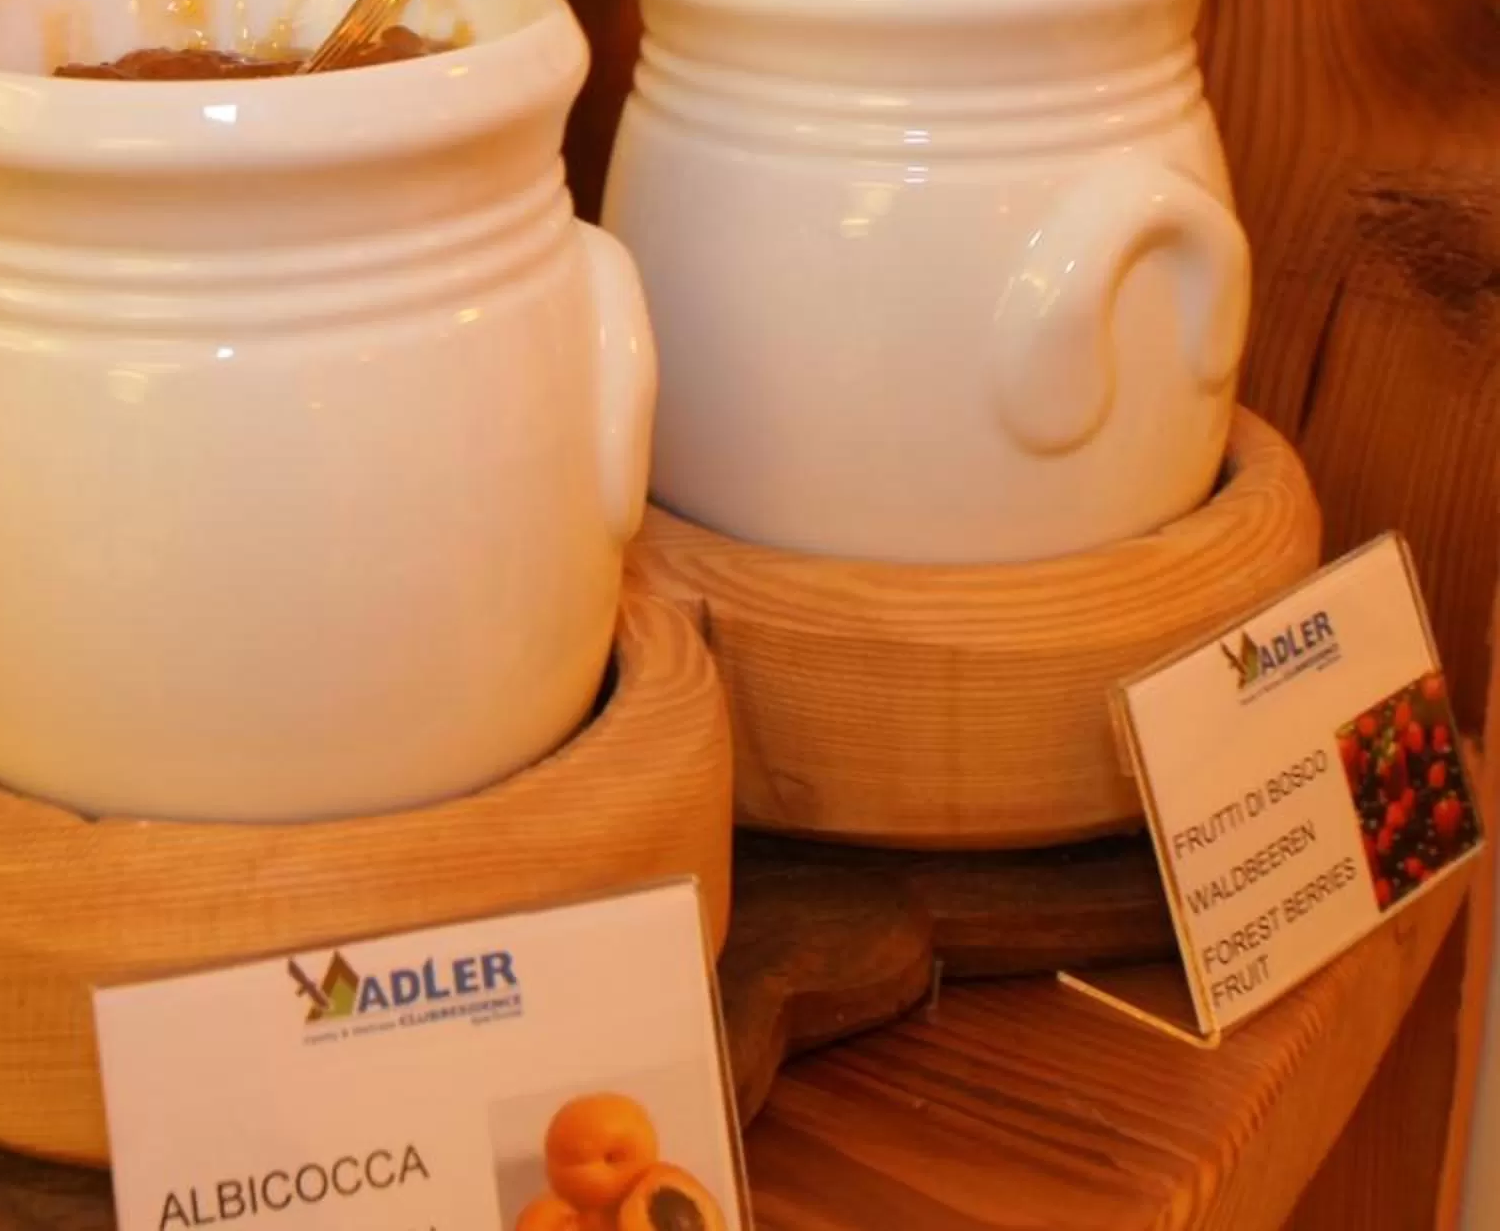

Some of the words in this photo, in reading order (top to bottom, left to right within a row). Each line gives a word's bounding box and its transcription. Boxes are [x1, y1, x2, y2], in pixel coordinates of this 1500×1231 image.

[1261, 611, 1334, 675] ADLER
[1172, 802, 1244, 860] FRUTTI
[1244, 788, 1266, 818] DI
[1266, 749, 1328, 805] BOSCO
[1185, 819, 1316, 915] WALDBEEREN
[1202, 906, 1280, 974] FOREST
[1281, 856, 1357, 923] BERRIES
[358, 950, 517, 1014] ADLER
[1209, 954, 1269, 1008] FRUIT
[158, 1143, 431, 1231] ALBICOCCA
